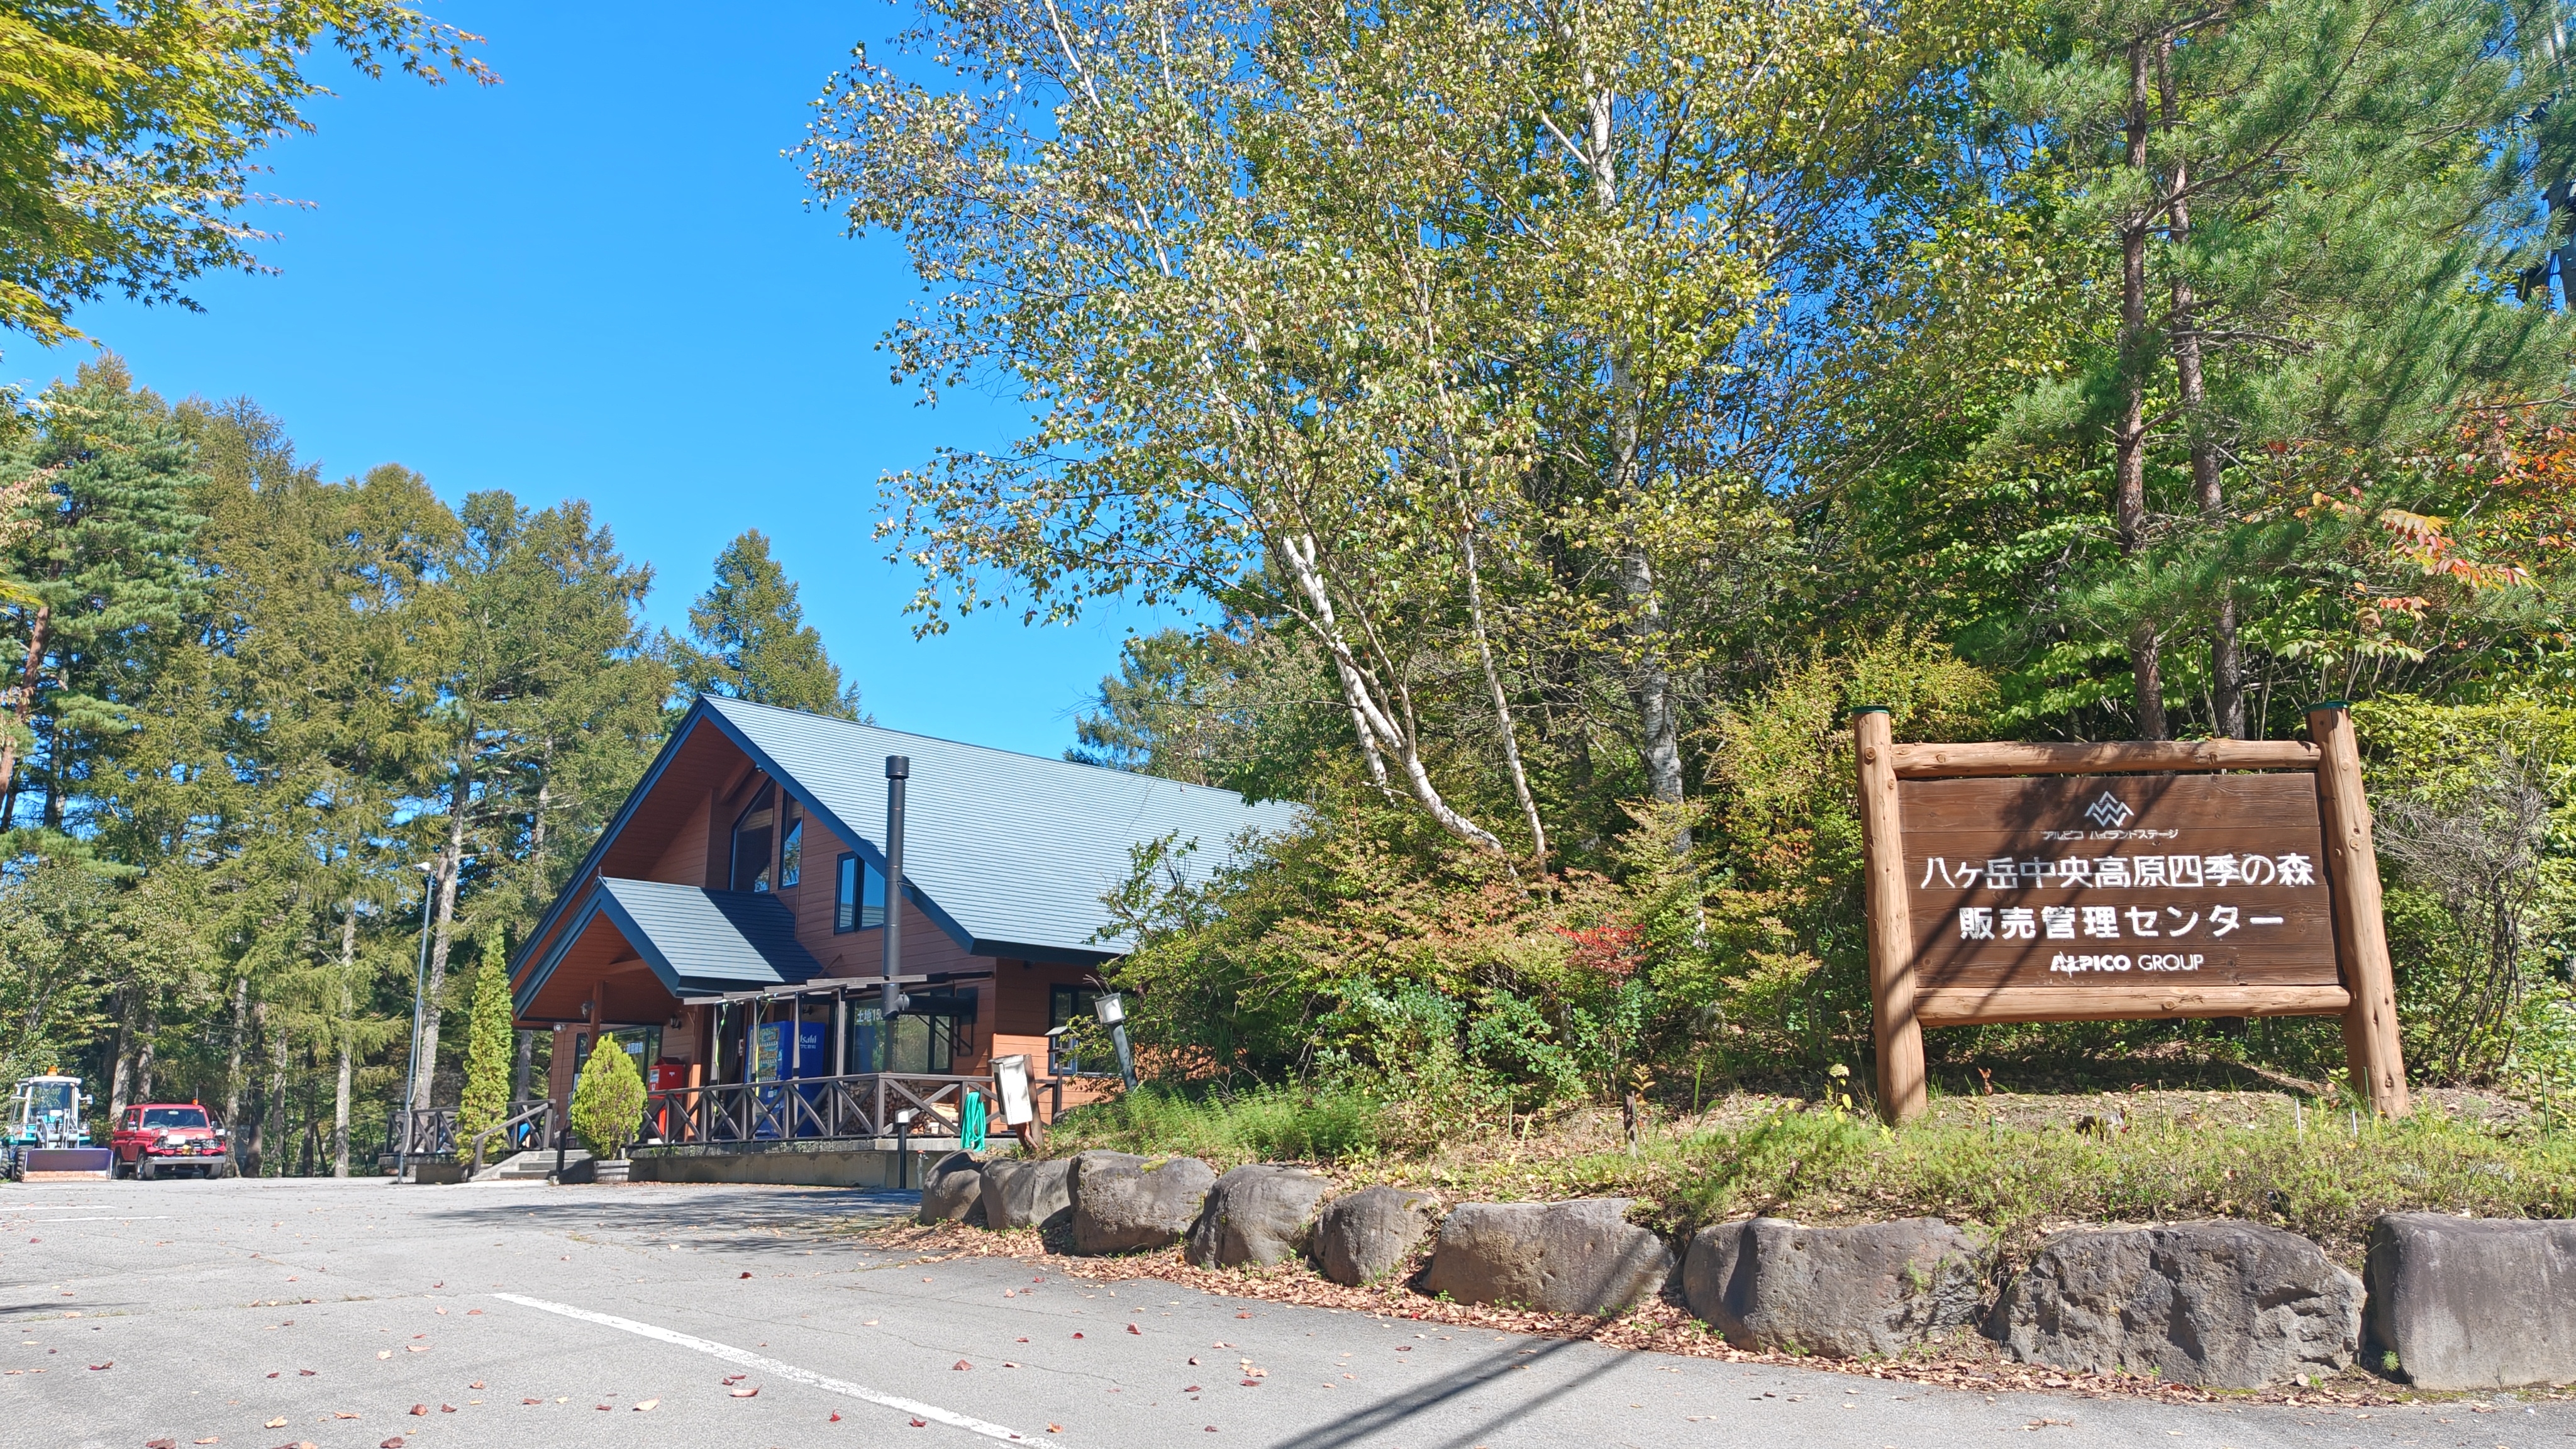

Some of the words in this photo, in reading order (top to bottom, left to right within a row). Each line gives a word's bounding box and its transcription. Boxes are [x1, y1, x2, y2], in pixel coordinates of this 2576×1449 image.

[1959, 904, 2284, 940] 販売管理センター
[2050, 952, 2131, 977] ALPICO
[2138, 954, 2204, 972] GROUP
